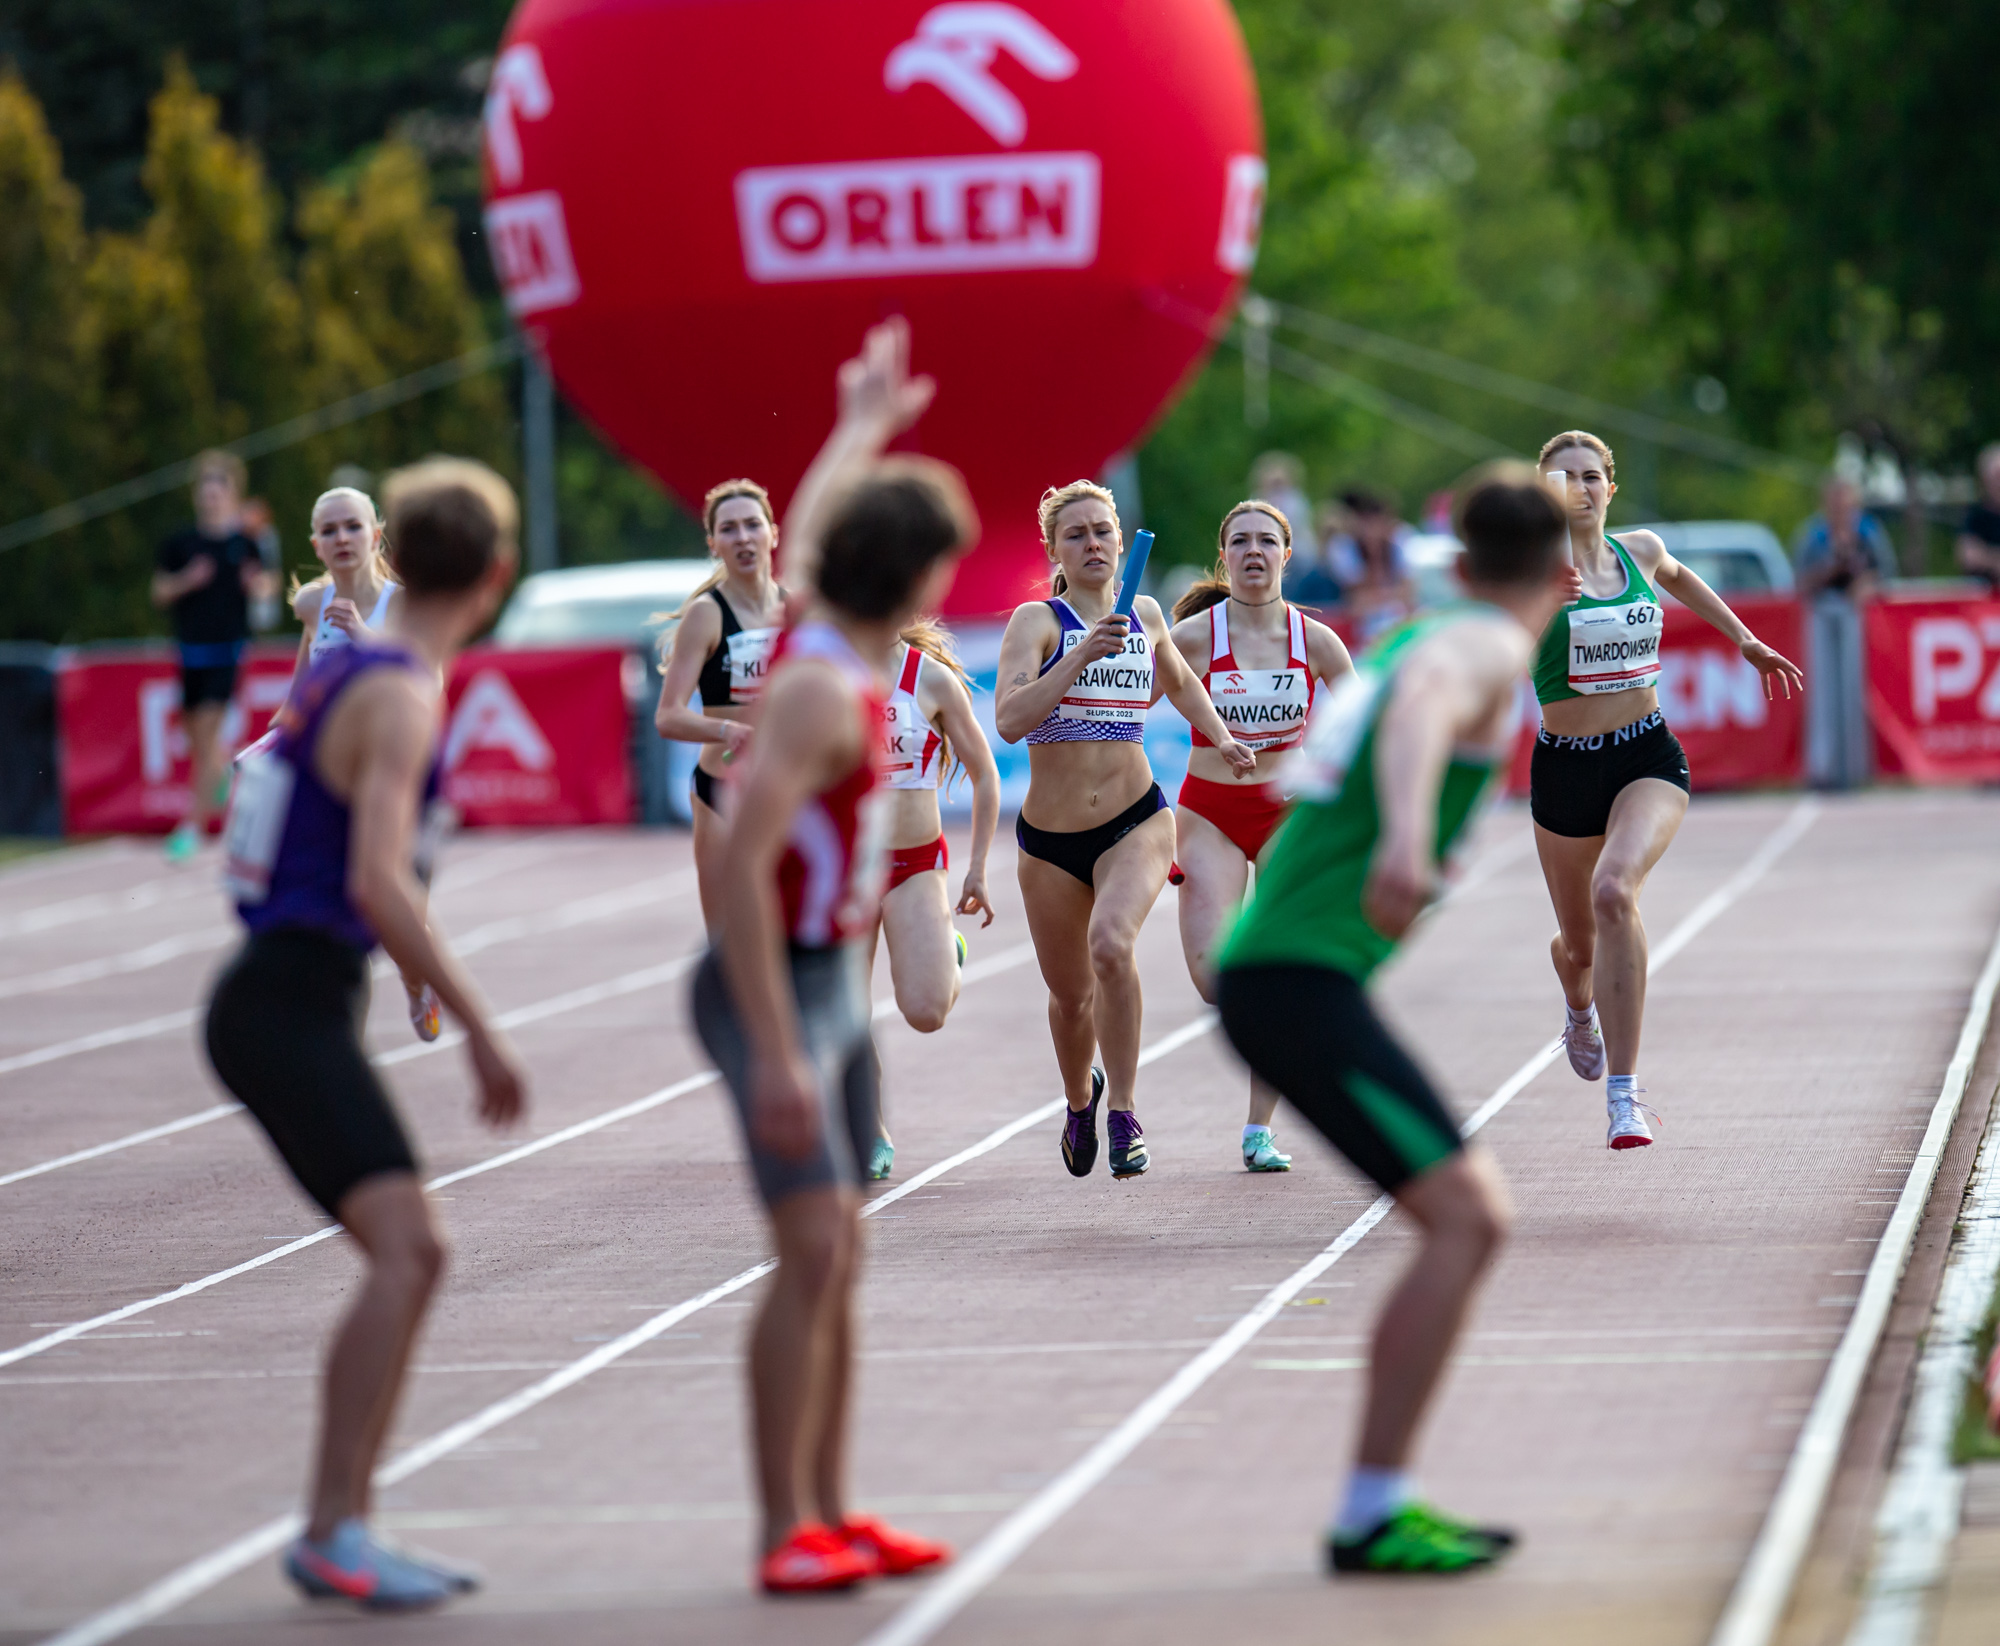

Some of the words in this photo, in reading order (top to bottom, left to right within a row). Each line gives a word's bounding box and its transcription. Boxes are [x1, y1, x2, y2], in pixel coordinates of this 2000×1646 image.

[769, 176, 1070, 253] ORLEN
[1626, 606, 1655, 625] 667
[1122, 637, 1146, 655] 10
[1574, 636, 1658, 664] TWARDOWSKA
[744, 660, 768, 679] KL
[1073, 667, 1151, 690] RAWCZYK
[1271, 674, 1295, 691] 77
[1595, 682, 1626, 691] SŁUPSK
[1627, 678, 1646, 688] 2023
[1116, 710, 1134, 718] 2023
[1215, 704, 1304, 723] NAWACKA
[1554, 734, 1605, 751] PRO
[1614, 709, 1662, 746] NIKE
[880, 736, 905, 755] AK
